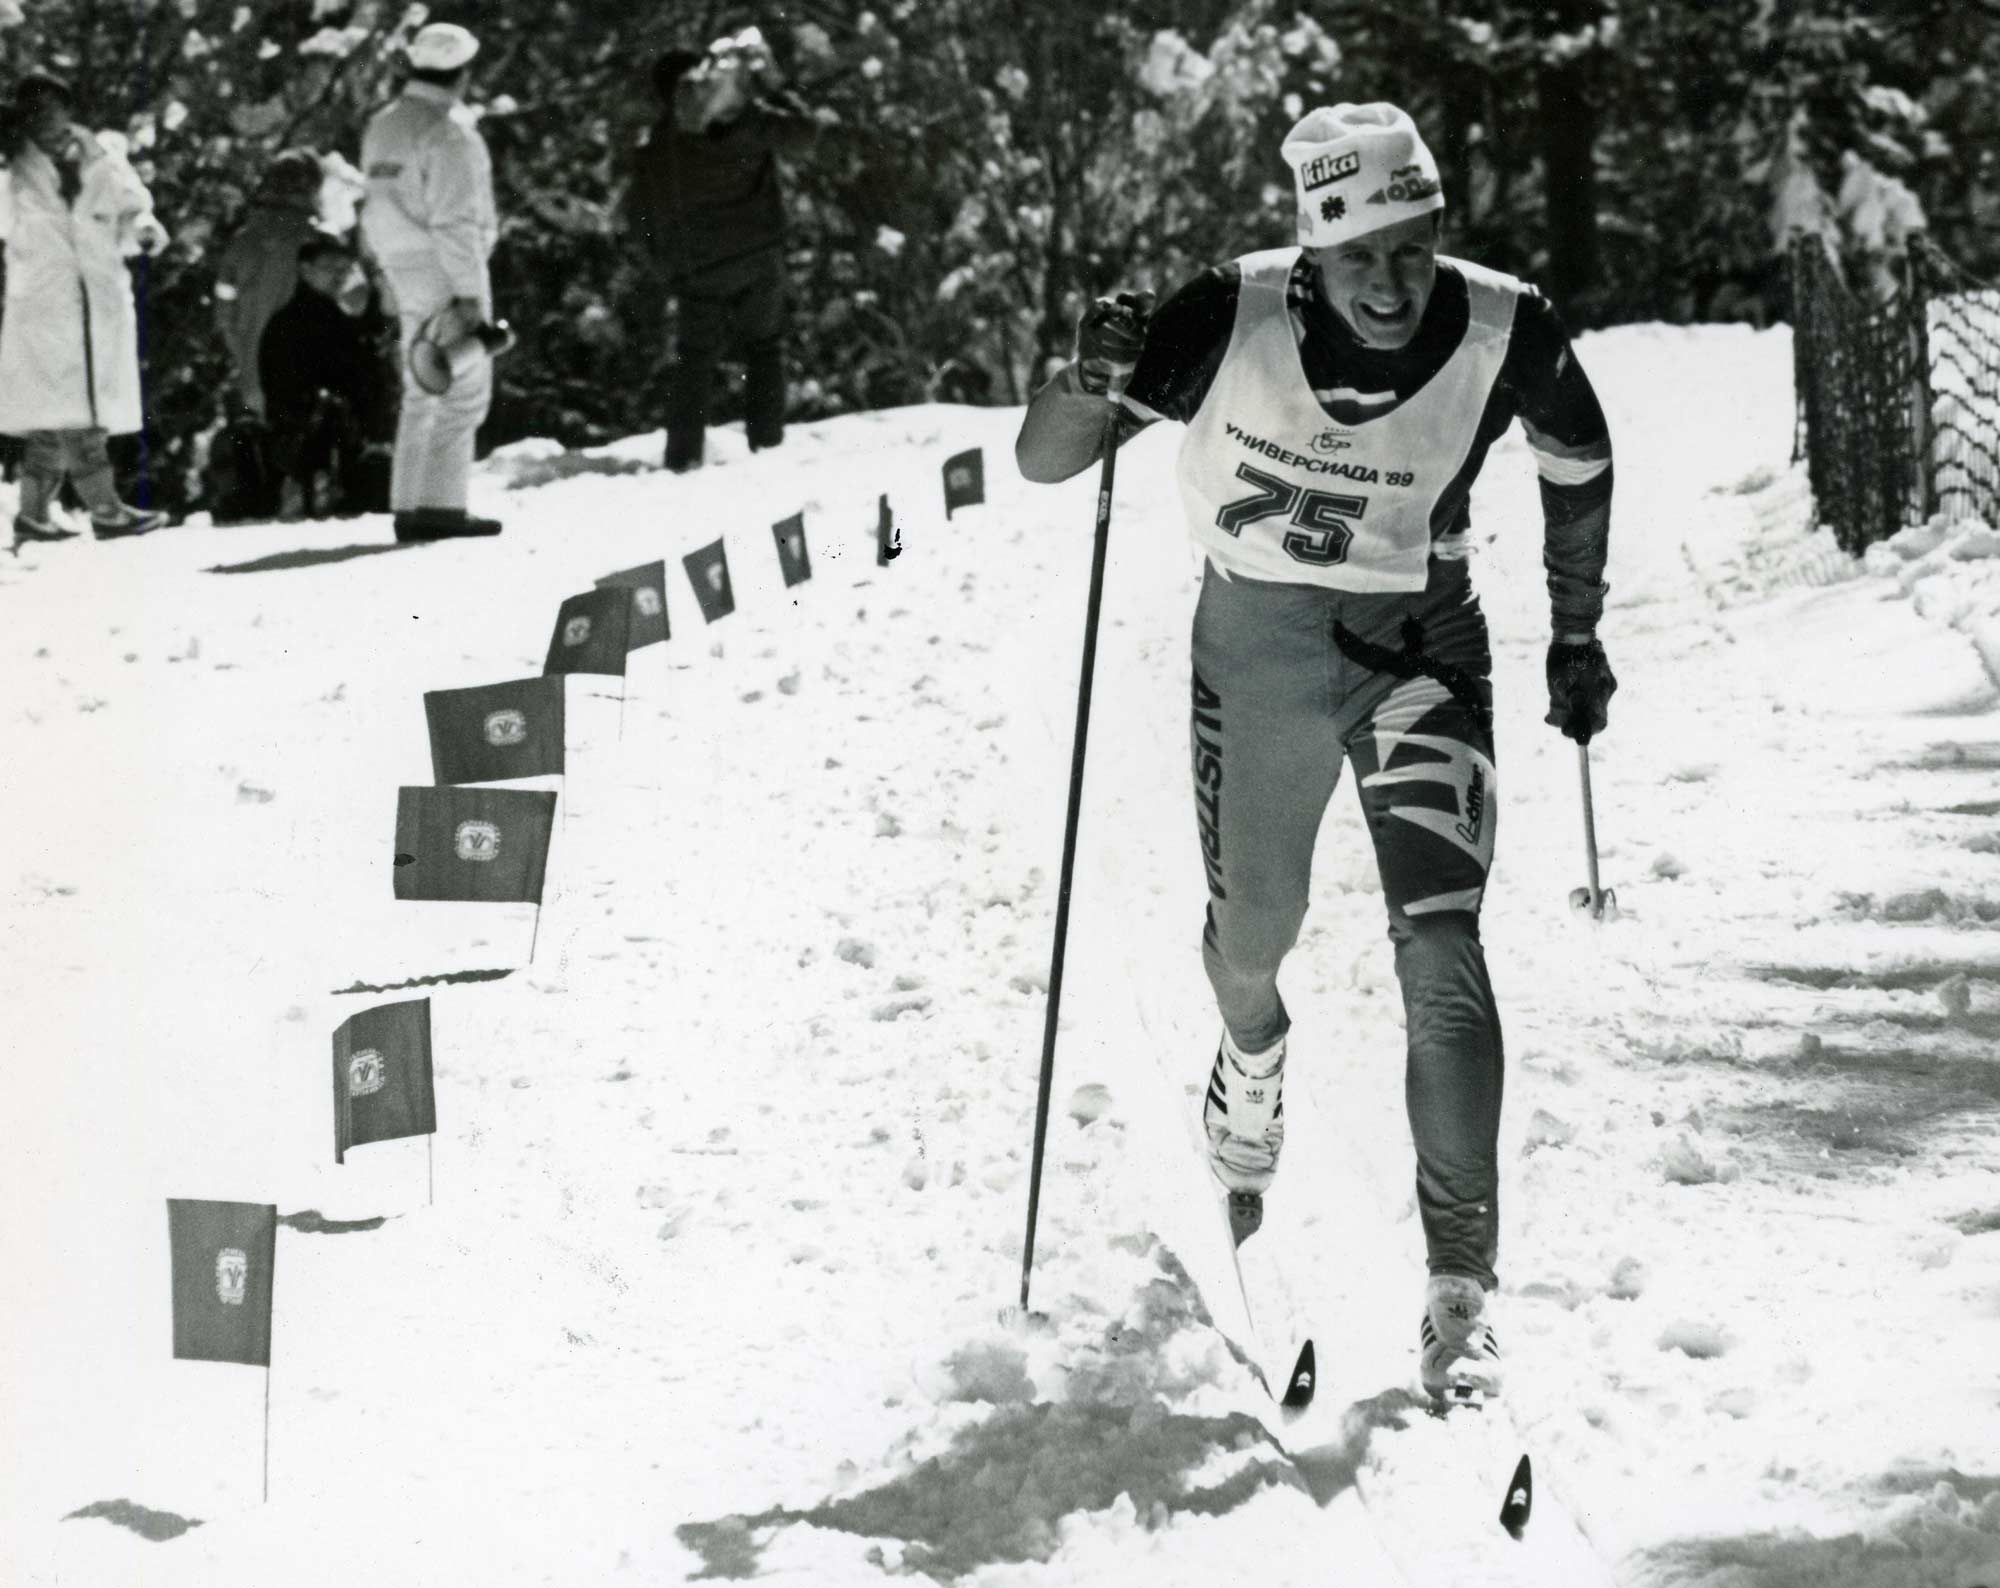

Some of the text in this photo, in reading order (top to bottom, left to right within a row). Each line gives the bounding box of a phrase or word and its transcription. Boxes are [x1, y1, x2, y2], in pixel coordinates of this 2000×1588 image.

[1302, 151, 1360, 192] kika
[1225, 422, 1415, 488] УНИВЕРСИАДА '89
[1215, 461, 1369, 567] 75
